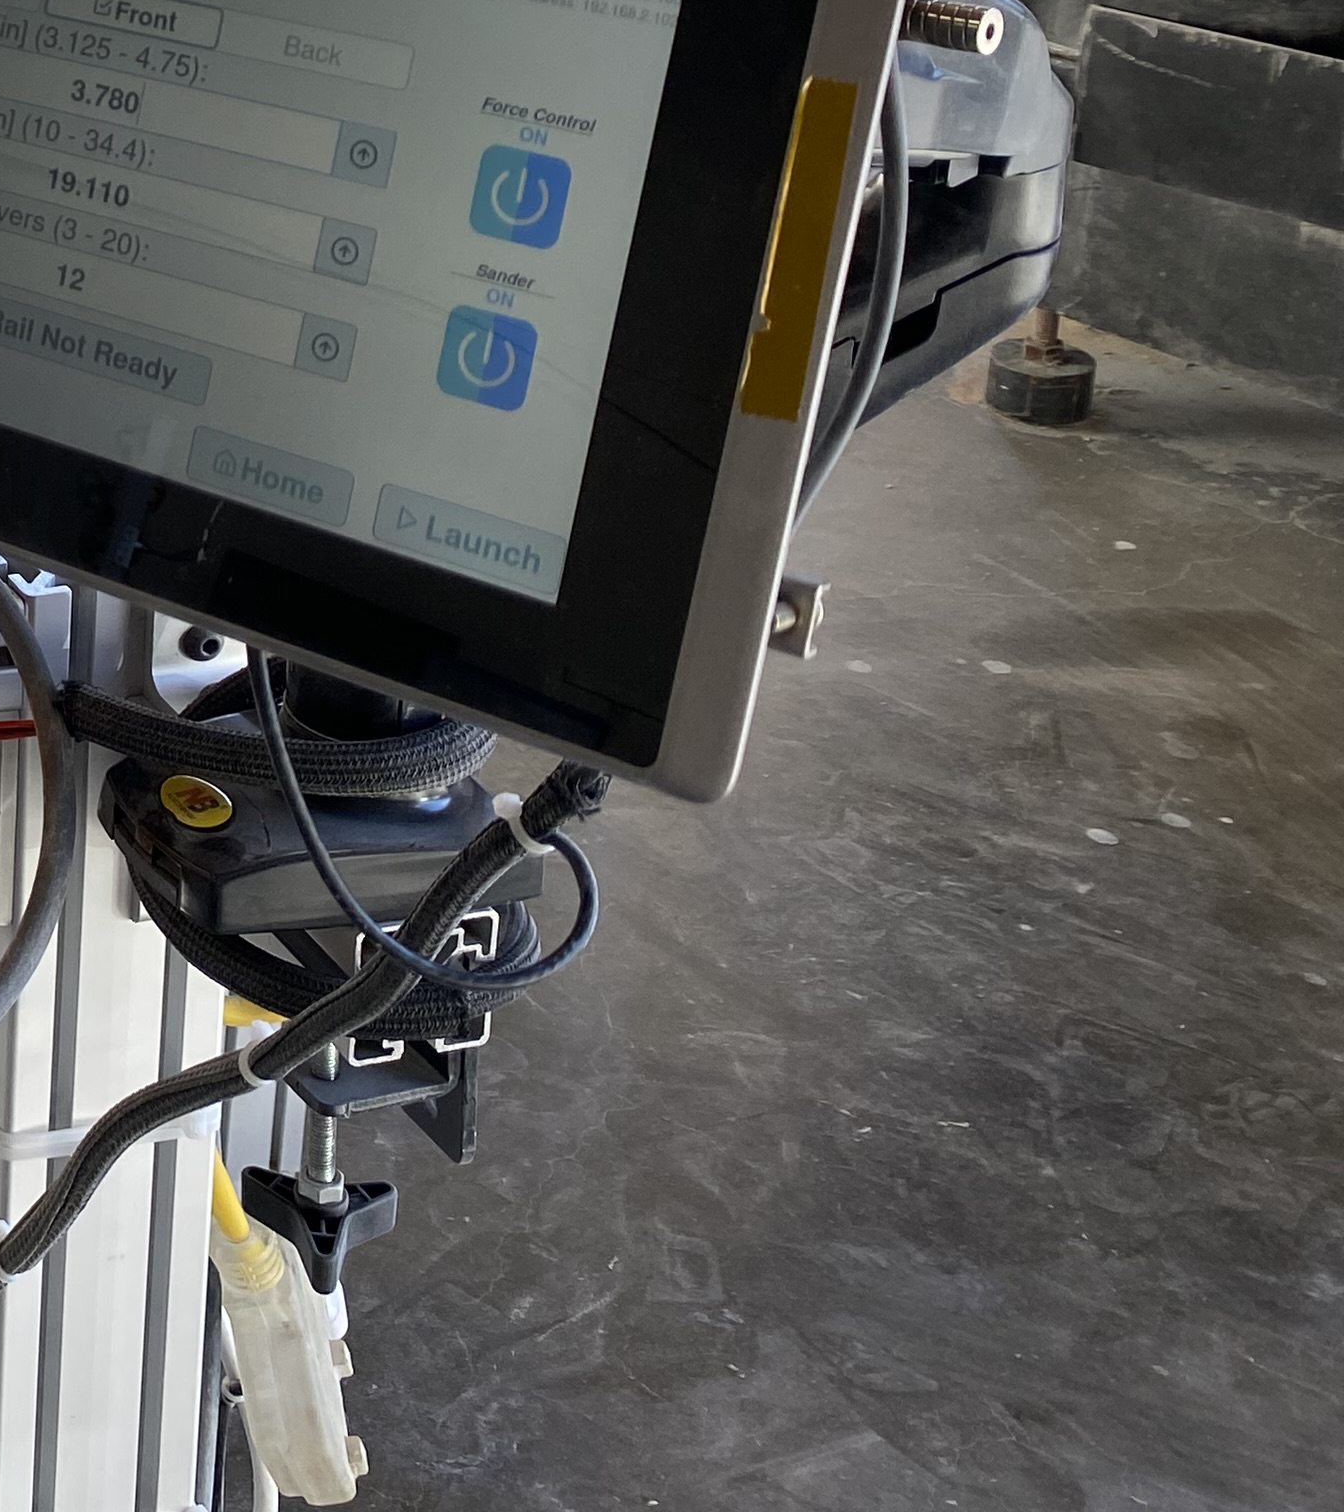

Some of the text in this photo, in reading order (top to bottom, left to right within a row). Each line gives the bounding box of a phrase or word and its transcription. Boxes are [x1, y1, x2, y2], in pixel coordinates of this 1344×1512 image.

[115, 0, 178, 32] Front
[35, 22, 112, 60] (3.125
[135, 45, 209, 86] 4.75):
[283, 34, 343, 68] Back
[70, 78, 141, 114] 3.780
[481, 96, 598, 133] Force Control
[22, 113, 61, 143] (10
[83, 128, 157, 170] 34.4):
[519, 127, 548, 147] ON
[48, 167, 131, 208] 19.110
[53, 213, 79, 246] (3
[99, 227, 150, 264] 20):
[57, 263, 86, 291] 12
[476, 263, 536, 290] Sander
[486, 288, 515, 309] ON
[40, 323, 87, 359] Not
[93, 339, 178, 390] Ready
[241, 456, 325, 505] Home
[424, 514, 542, 575] Launch
